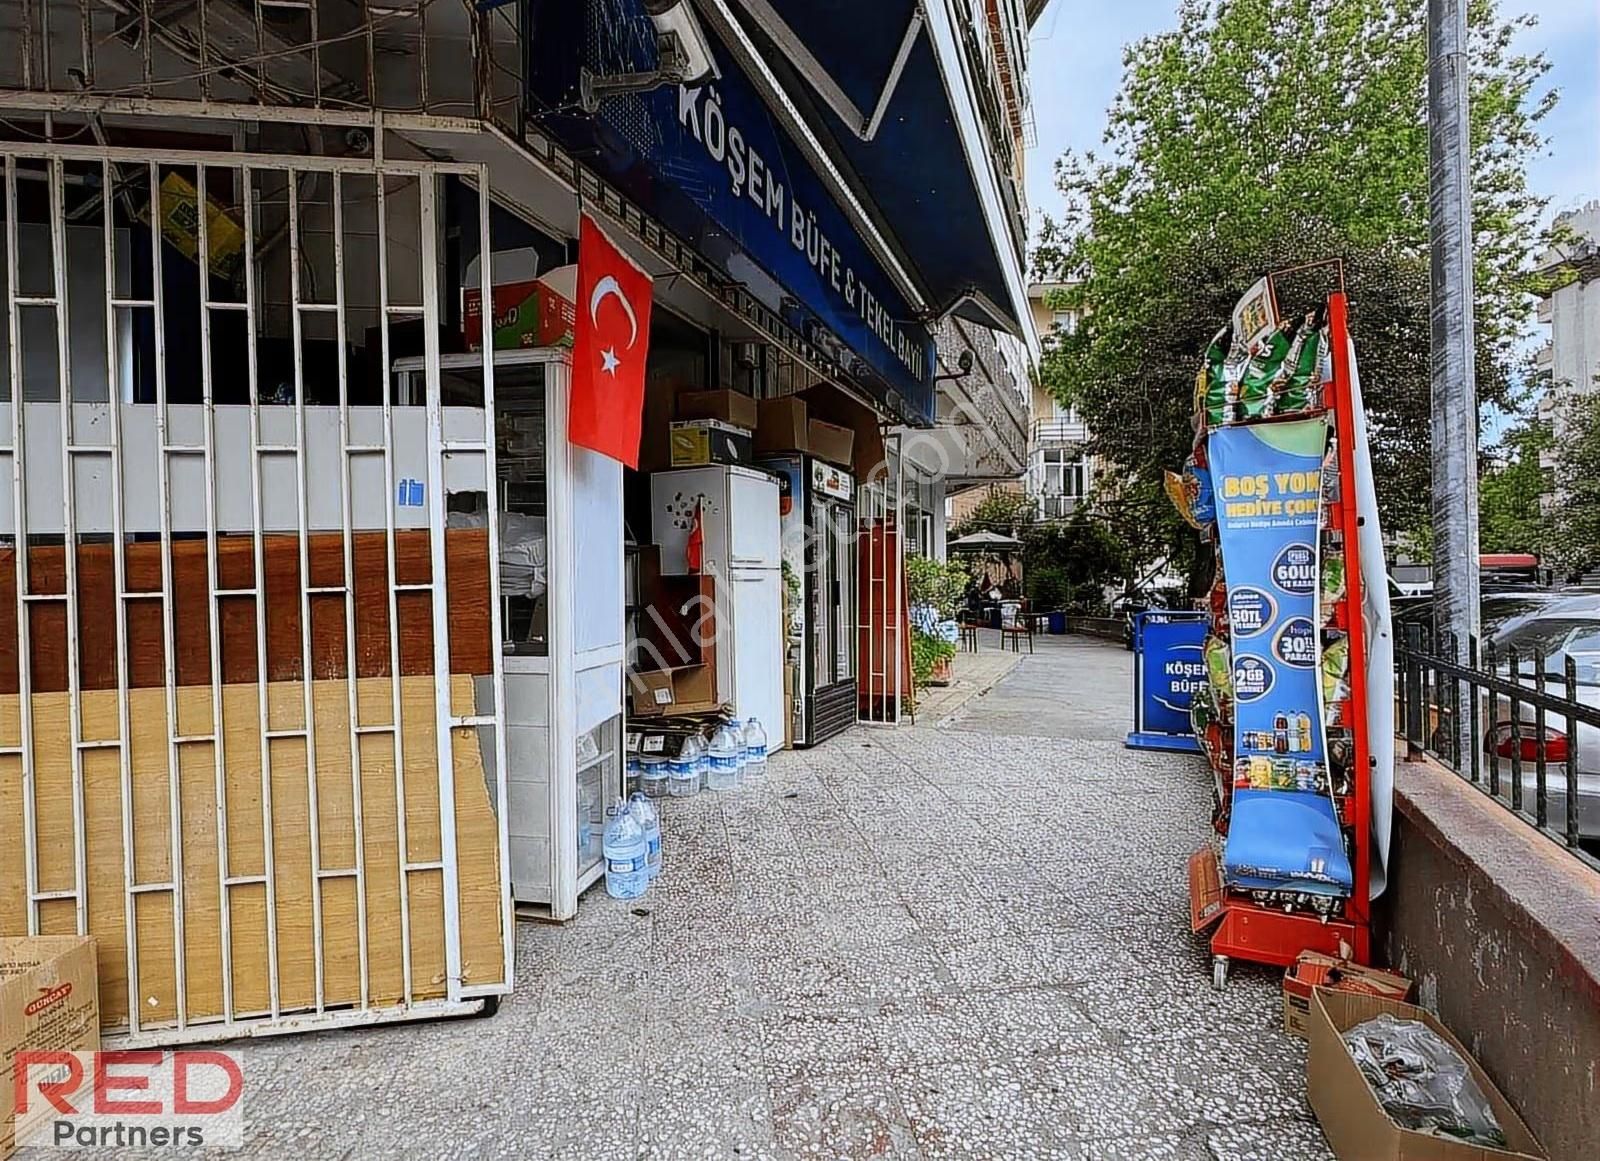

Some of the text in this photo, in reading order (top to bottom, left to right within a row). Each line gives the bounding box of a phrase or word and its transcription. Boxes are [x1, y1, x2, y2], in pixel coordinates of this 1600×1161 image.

[679, 84, 784, 231] KÖŞEM
[791, 198, 841, 292] BÜFE
[845, 267, 857, 309] &
[859, 280, 896, 354] TEKEL
[1224, 474, 1269, 500] BOŞ
[1225, 499, 1282, 518] HEDİYE
